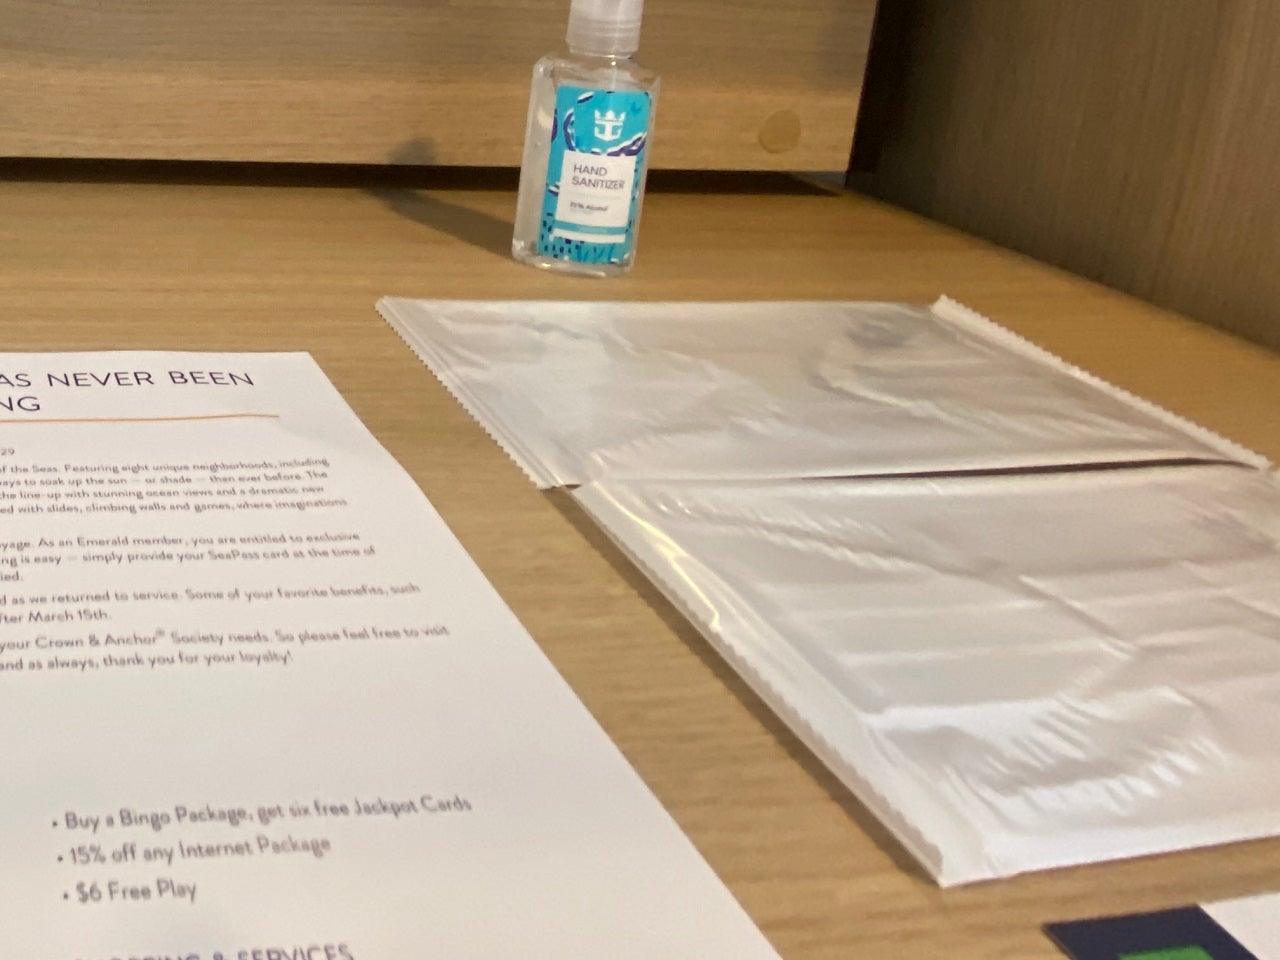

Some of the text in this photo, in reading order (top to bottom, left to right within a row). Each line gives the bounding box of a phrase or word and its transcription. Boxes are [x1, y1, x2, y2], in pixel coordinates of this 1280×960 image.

[573, 163, 608, 176] HAND
[571, 176, 625, 190] SANITIZER
[47, 371, 154, 387] NEVER
[168, 370, 254, 386] BEEN
[34, 635, 84, 649] Crown
[88, 633, 101, 647] &
[170, 631, 224, 646] Society
[228, 630, 273, 643] needs.
[274, 628, 295, 643] So
[297, 629, 341, 645] please
[342, 627, 370, 640] feel
[371, 626, 401, 639] free
[402, 626, 420, 638] to
[421, 625, 450, 636] visit
[27, 659, 43, 671] as
[47, 656, 99, 672] always,
[102, 652, 145, 667] thank
[147, 655, 175, 669] you
[177, 650, 199, 664] for
[203, 653, 236, 667] your
[238, 649, 293, 666] loyalty!
[64, 794, 472, 833] Buy a Bingo Package, get six free Jackpot Cards
[69, 834, 331, 866] 15% off any Internet Package
[75, 877, 196, 904] $6 Free Play
